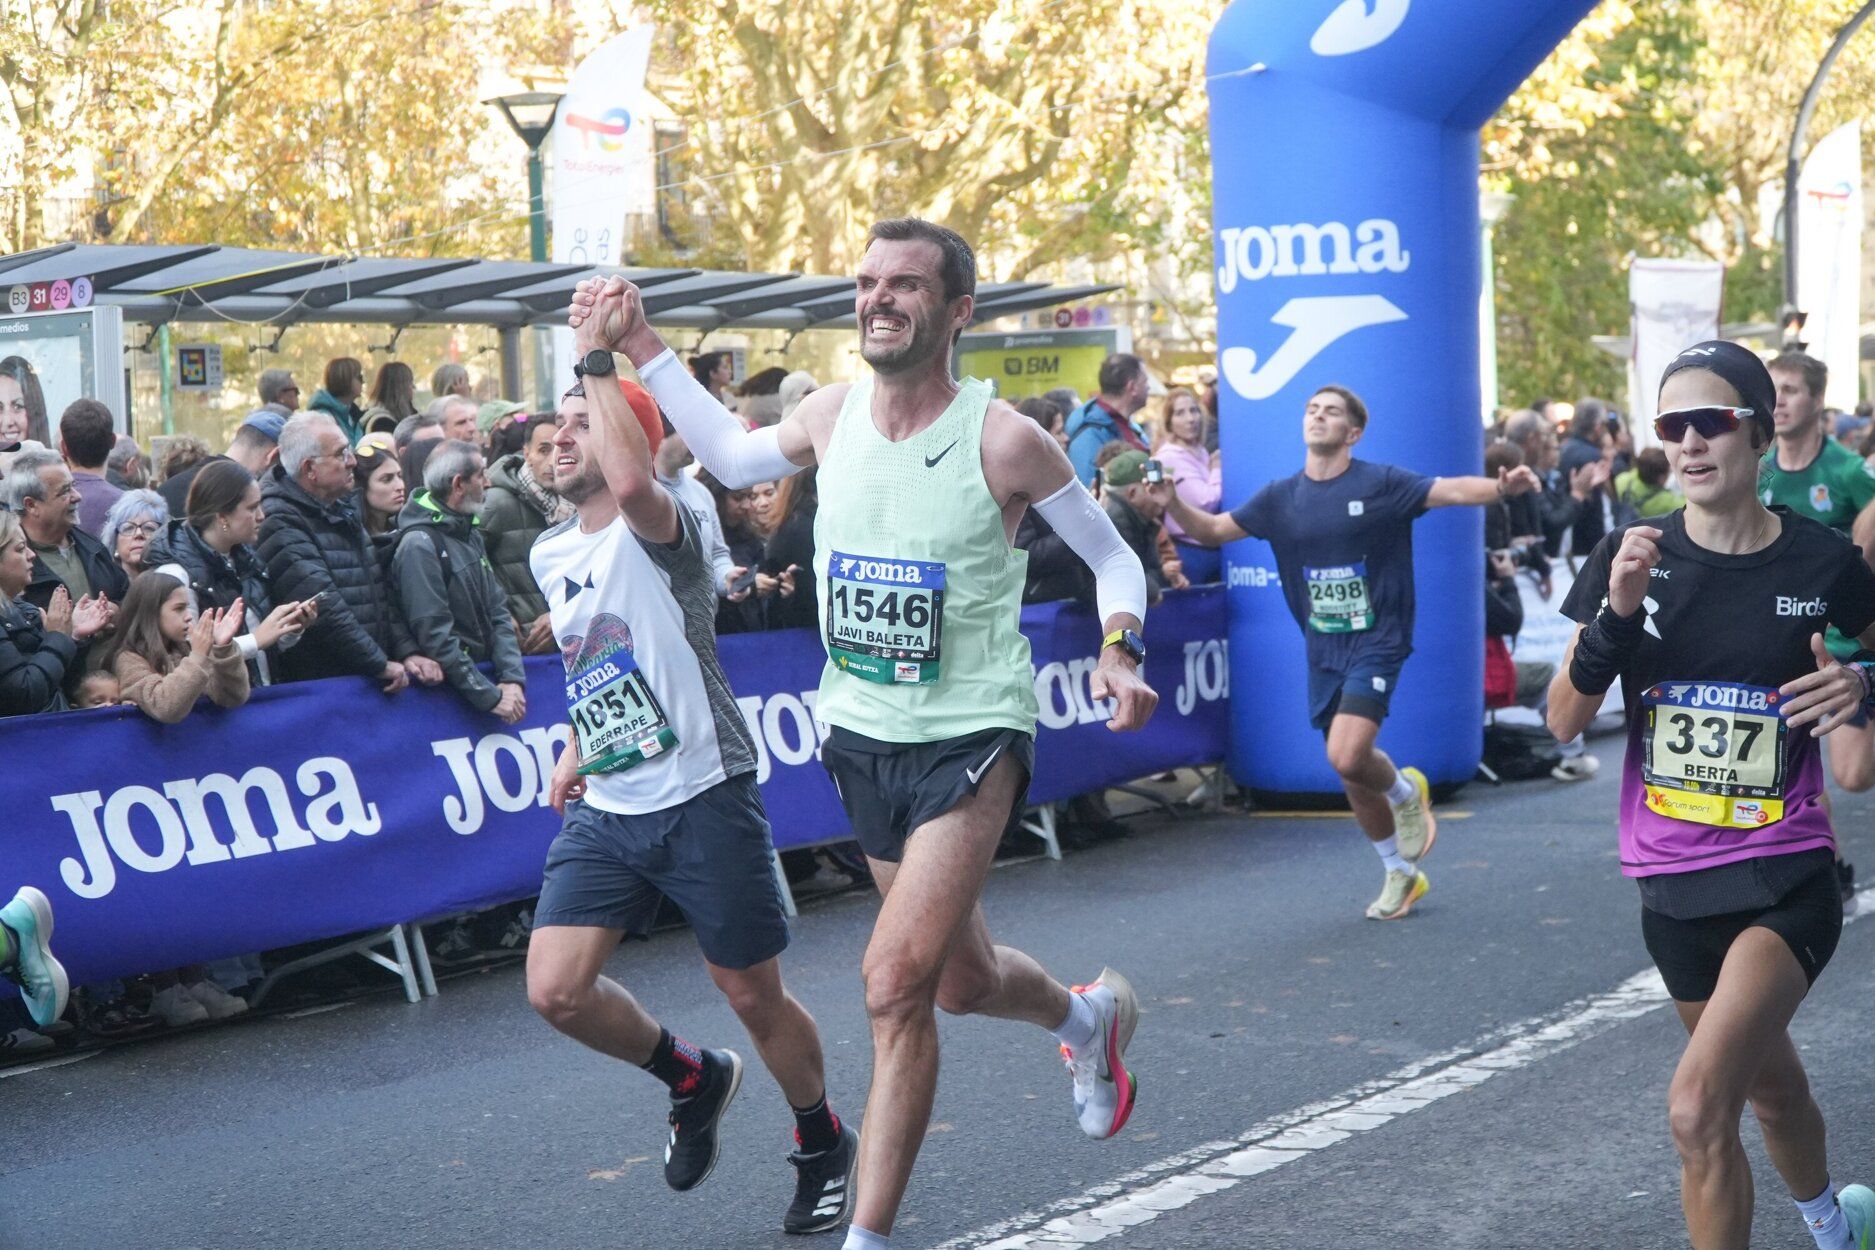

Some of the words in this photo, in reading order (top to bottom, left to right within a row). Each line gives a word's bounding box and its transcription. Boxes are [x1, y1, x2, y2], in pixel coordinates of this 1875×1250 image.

[1218, 217, 1411, 294] Joma
[12, 292, 27, 305] B3
[33, 288, 46, 304] 31
[54, 286, 68, 301] 29
[77, 284, 86, 299] 8
[1027, 355, 1060, 375] BM
[855, 561, 922, 584] Joma
[1311, 581, 1362, 601] 2498
[835, 585, 930, 629] 1546
[1776, 596, 1828, 616] Birds
[837, 625, 862, 641] JAVI
[866, 630, 925, 648] BALETA
[578, 662, 620, 696] Joma
[575, 679, 645, 738] 1851
[1691, 684, 1769, 711] Joma
[589, 714, 648, 753] EDERRAPE
[1665, 712, 1764, 762] 337
[1684, 763, 1739, 783] BERTA
[50, 756, 382, 899] Joma
